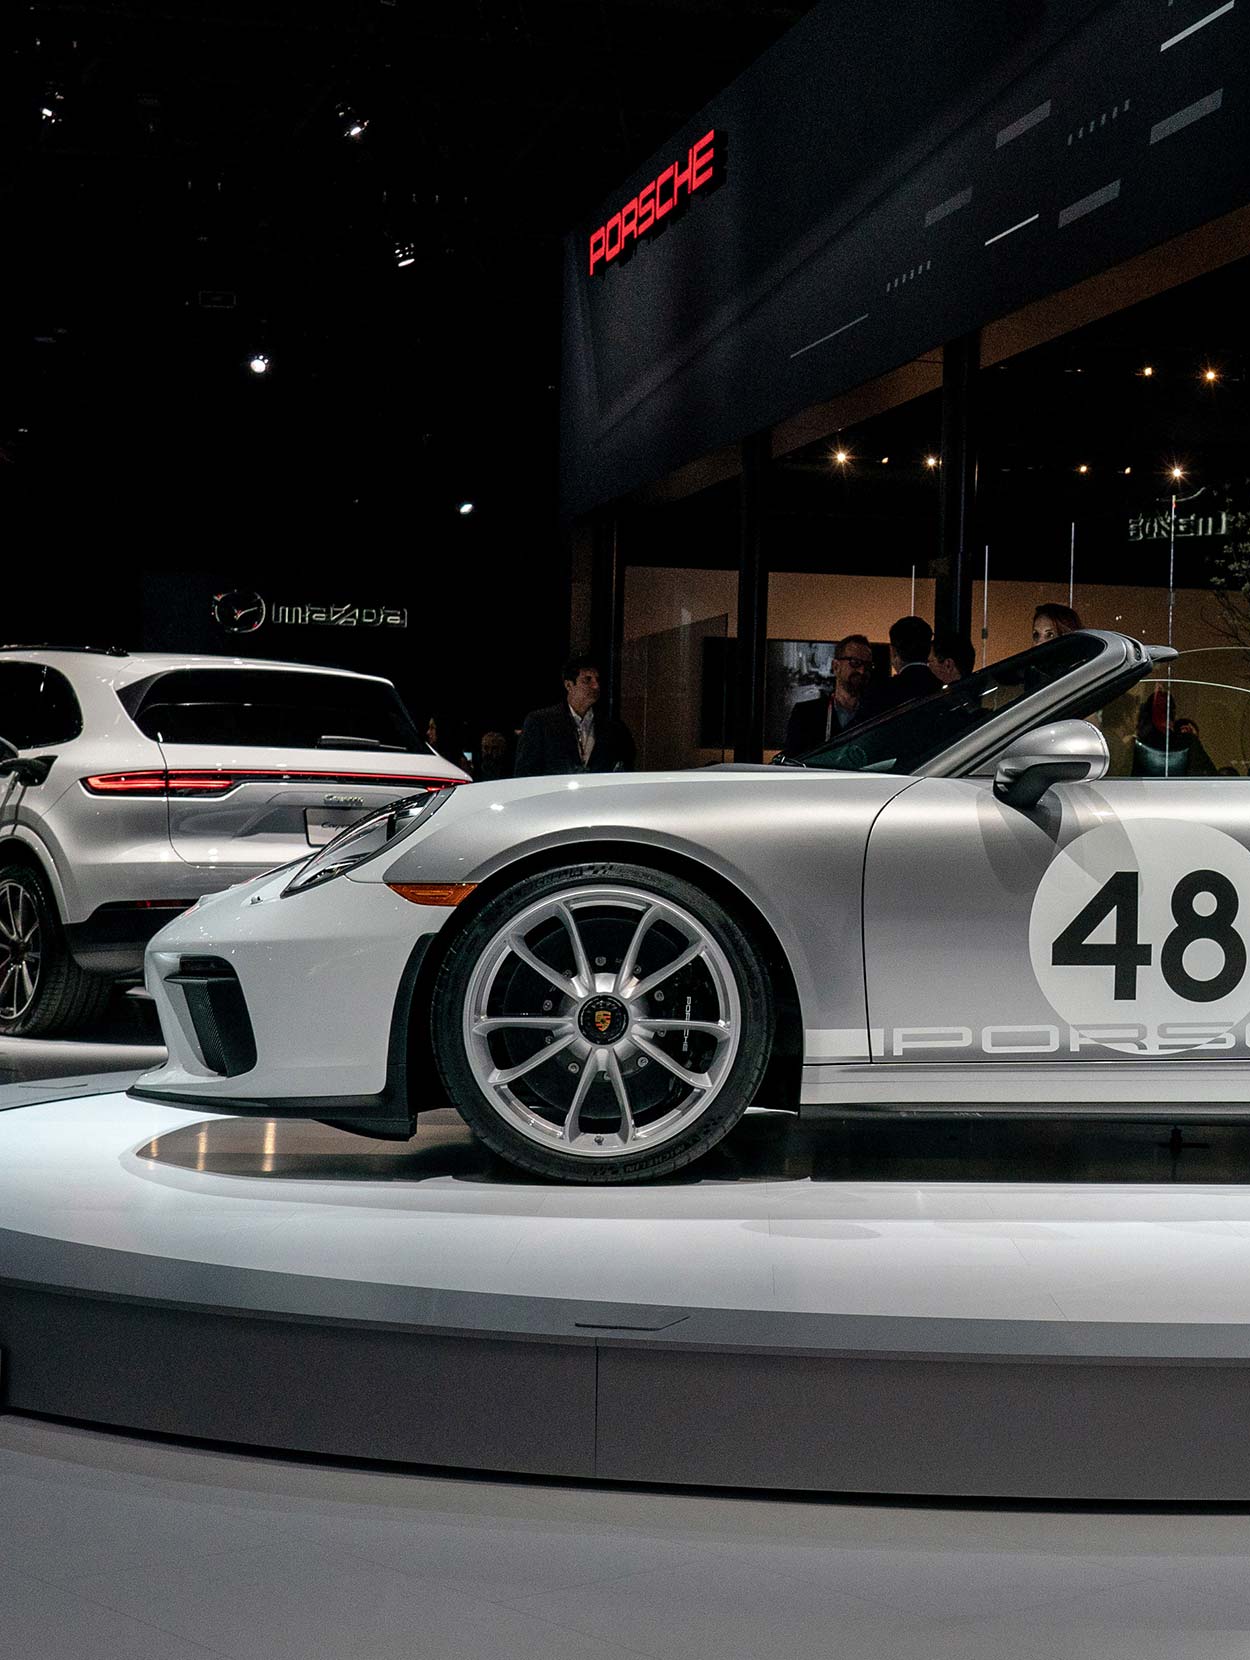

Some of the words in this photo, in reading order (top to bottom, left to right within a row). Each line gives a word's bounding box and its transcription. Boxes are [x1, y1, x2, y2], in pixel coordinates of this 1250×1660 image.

[590, 129, 714, 276] PORSCHE
[1052, 869, 1247, 1003] 48
[682, 996, 692, 1052] PORCHE
